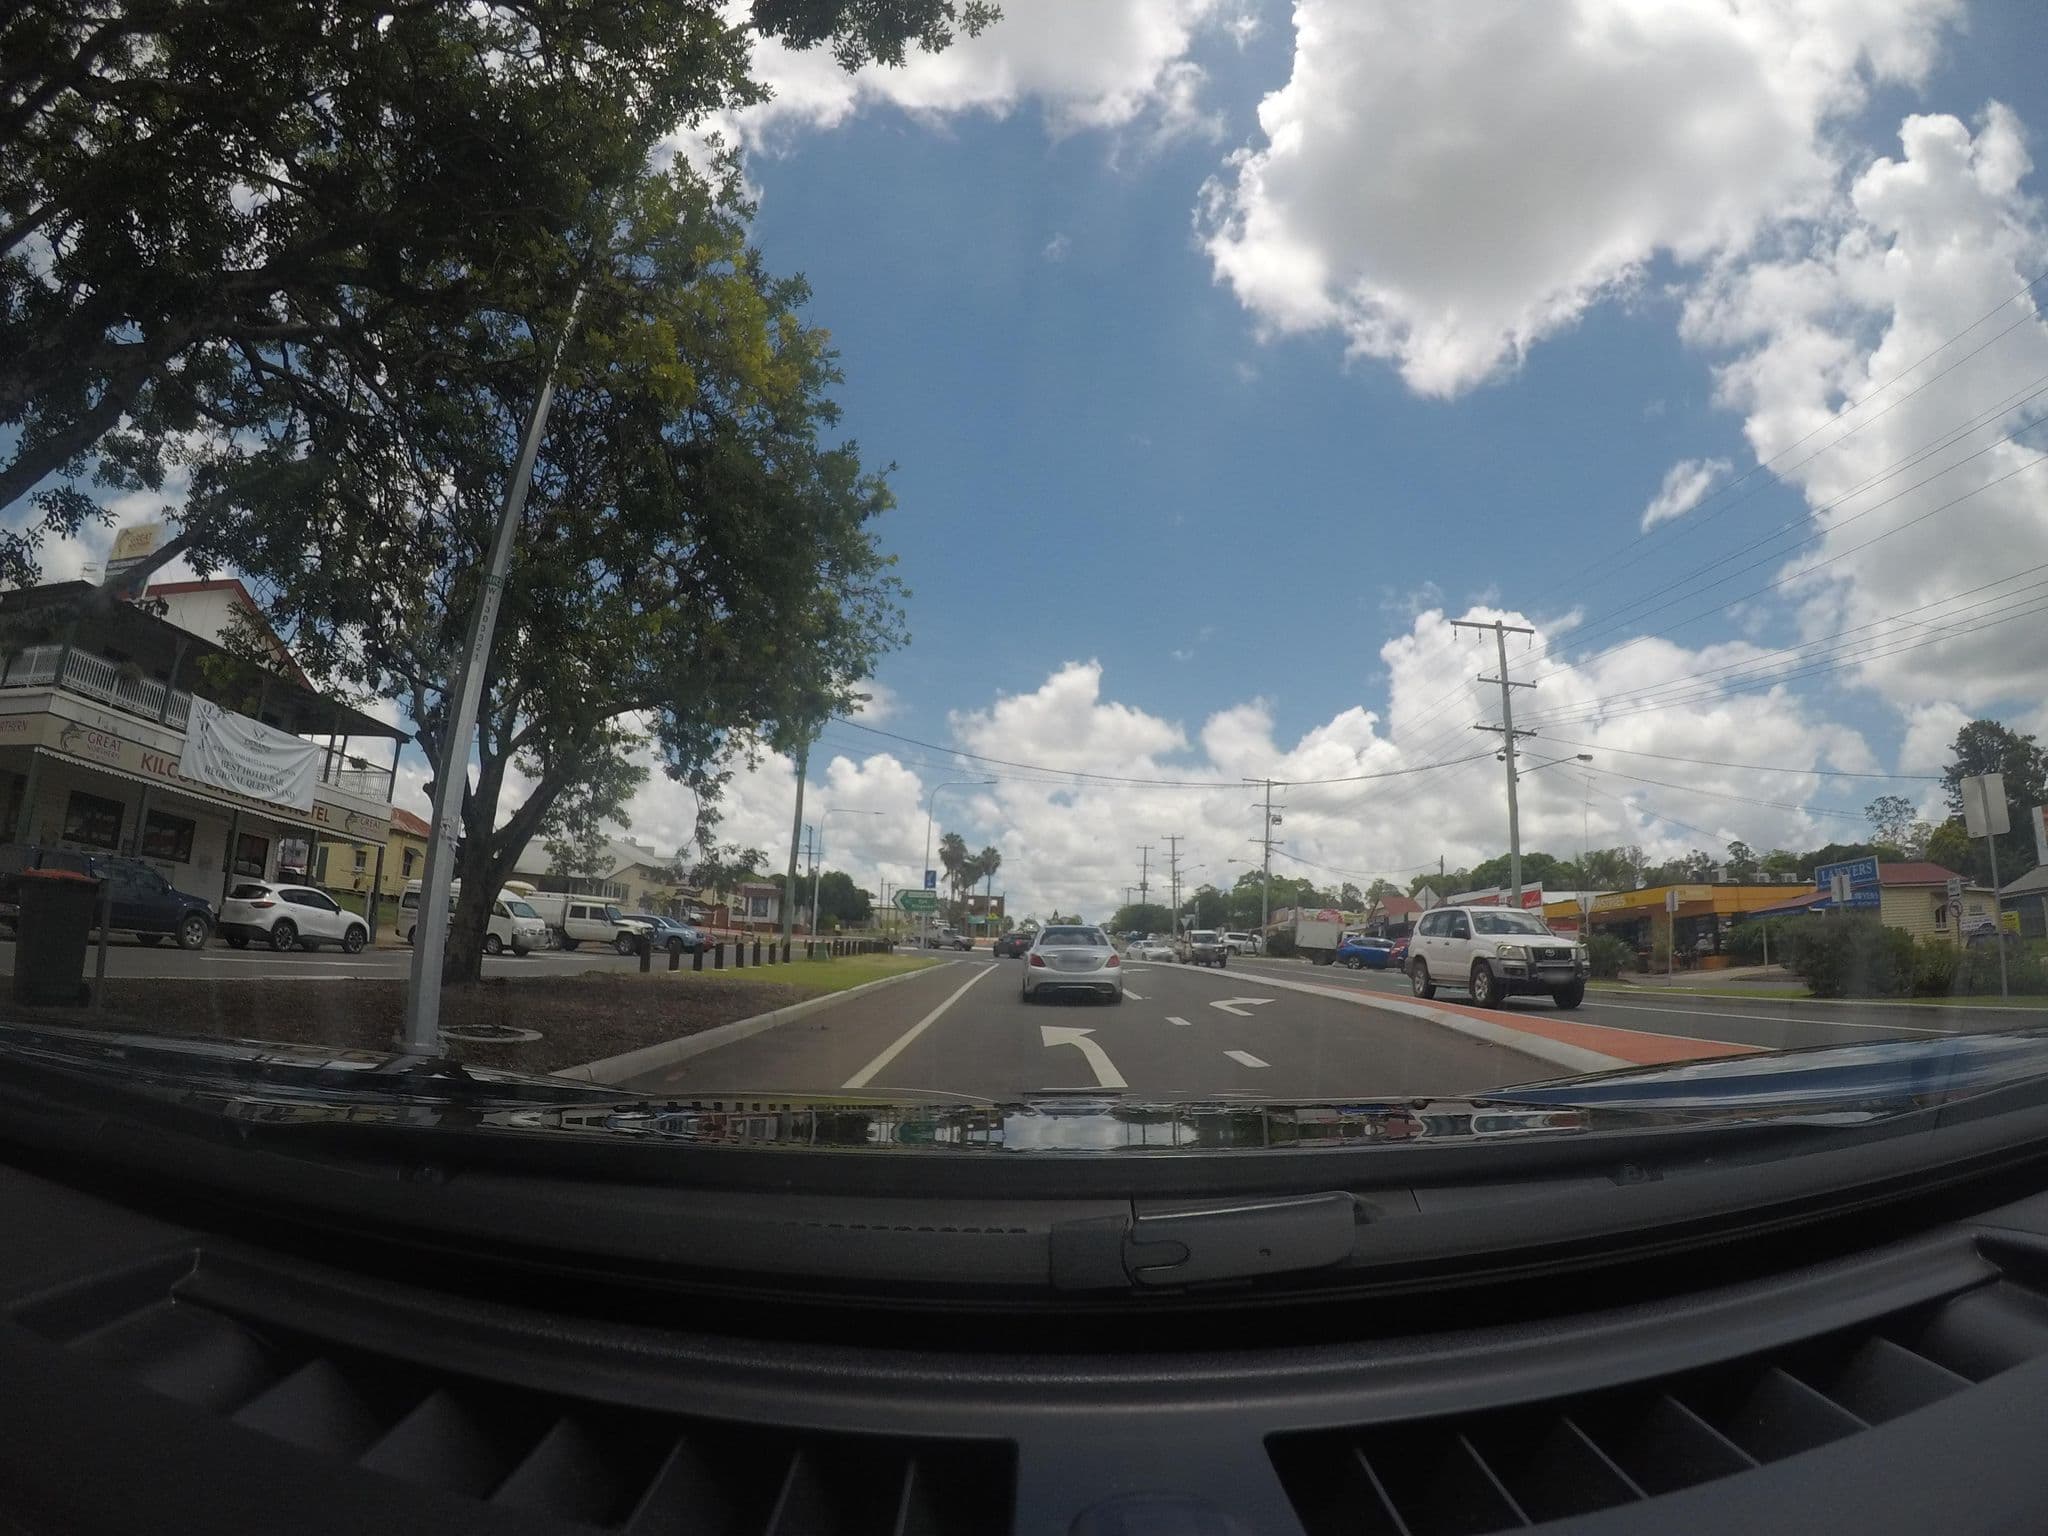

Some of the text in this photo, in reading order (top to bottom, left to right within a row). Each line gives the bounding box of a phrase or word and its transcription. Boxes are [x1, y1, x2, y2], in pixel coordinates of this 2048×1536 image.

[87, 731, 123, 752] GREAT
[204, 765, 244, 785] REGIONAL
[246, 779, 296, 799] QUEENSLAND
[222, 759, 241, 773] BEST
[243, 767, 267, 782] HOTEL
[269, 775, 285, 786] BAR
[360, 816, 381, 830] GREAT
